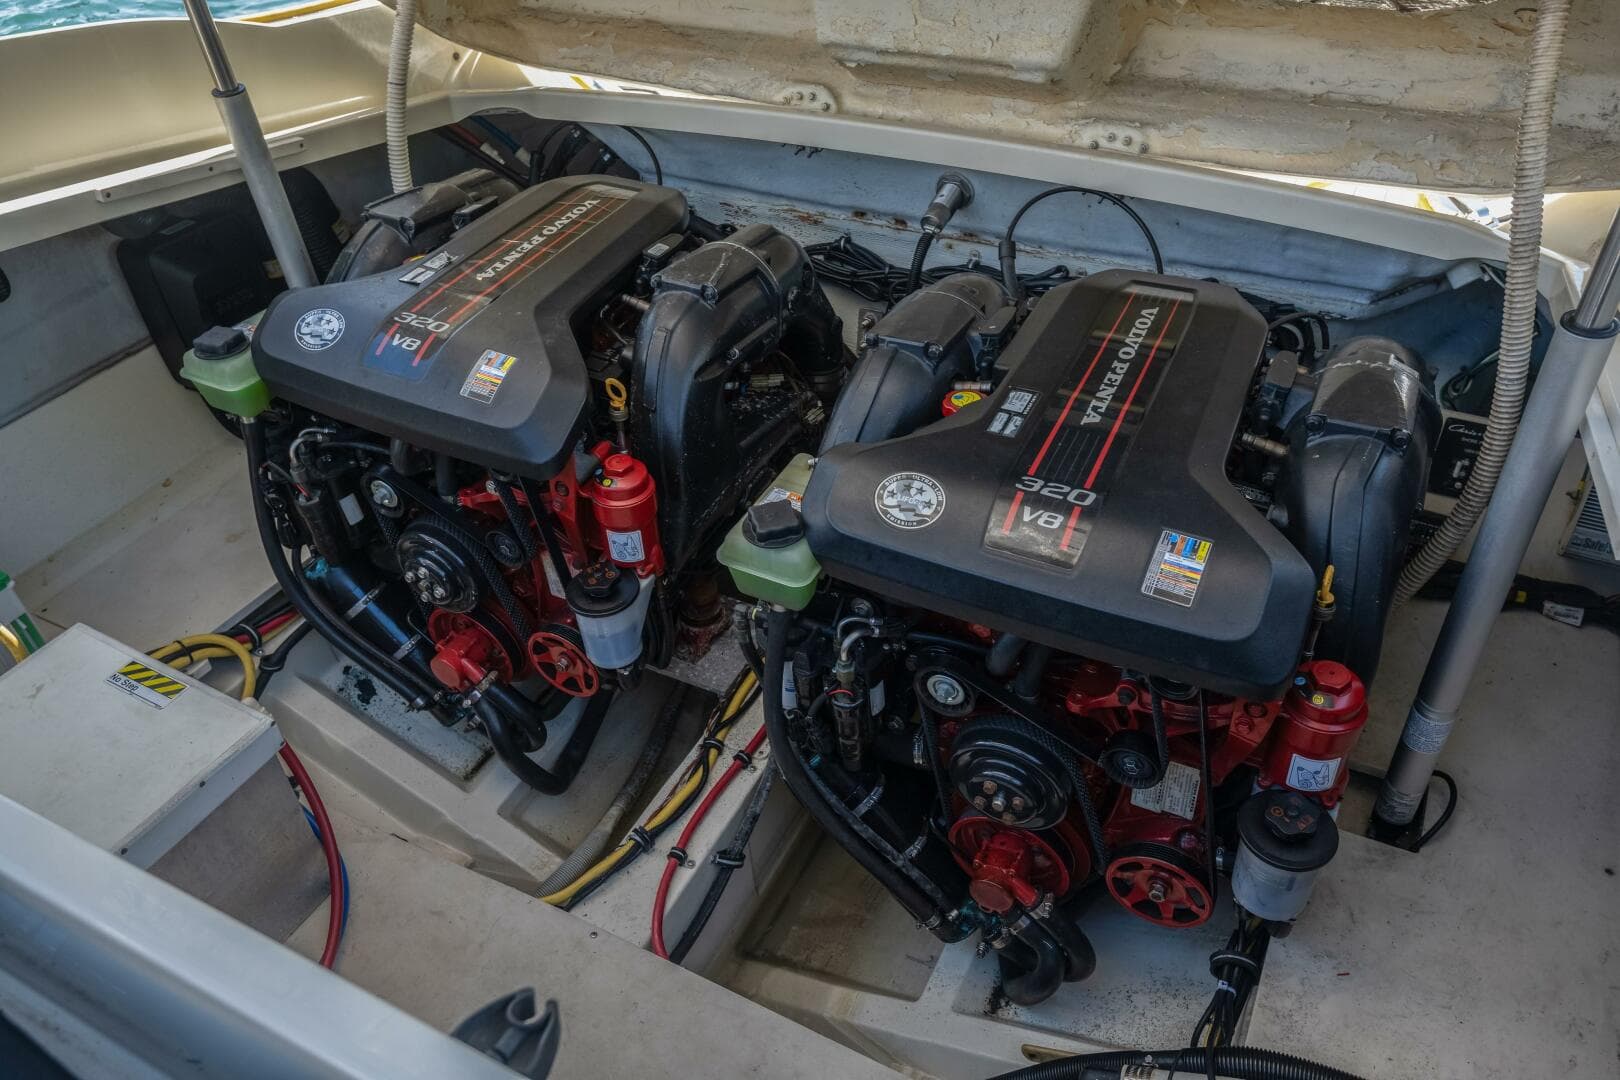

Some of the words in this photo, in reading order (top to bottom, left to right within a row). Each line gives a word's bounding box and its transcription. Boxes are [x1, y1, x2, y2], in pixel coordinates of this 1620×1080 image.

[542, 199, 601, 236] VOLVO
[476, 234, 547, 281] PENTA
[394, 312, 450, 332] 320
[1118, 306, 1160, 360] VOLVO
[392, 333, 421, 350] V8
[1080, 360, 1130, 425] PENTA
[1015, 476, 1097, 506] 320
[1022, 505, 1065, 529] V8
[110, 673, 121, 683] No
[121, 679, 140, 692] Step
